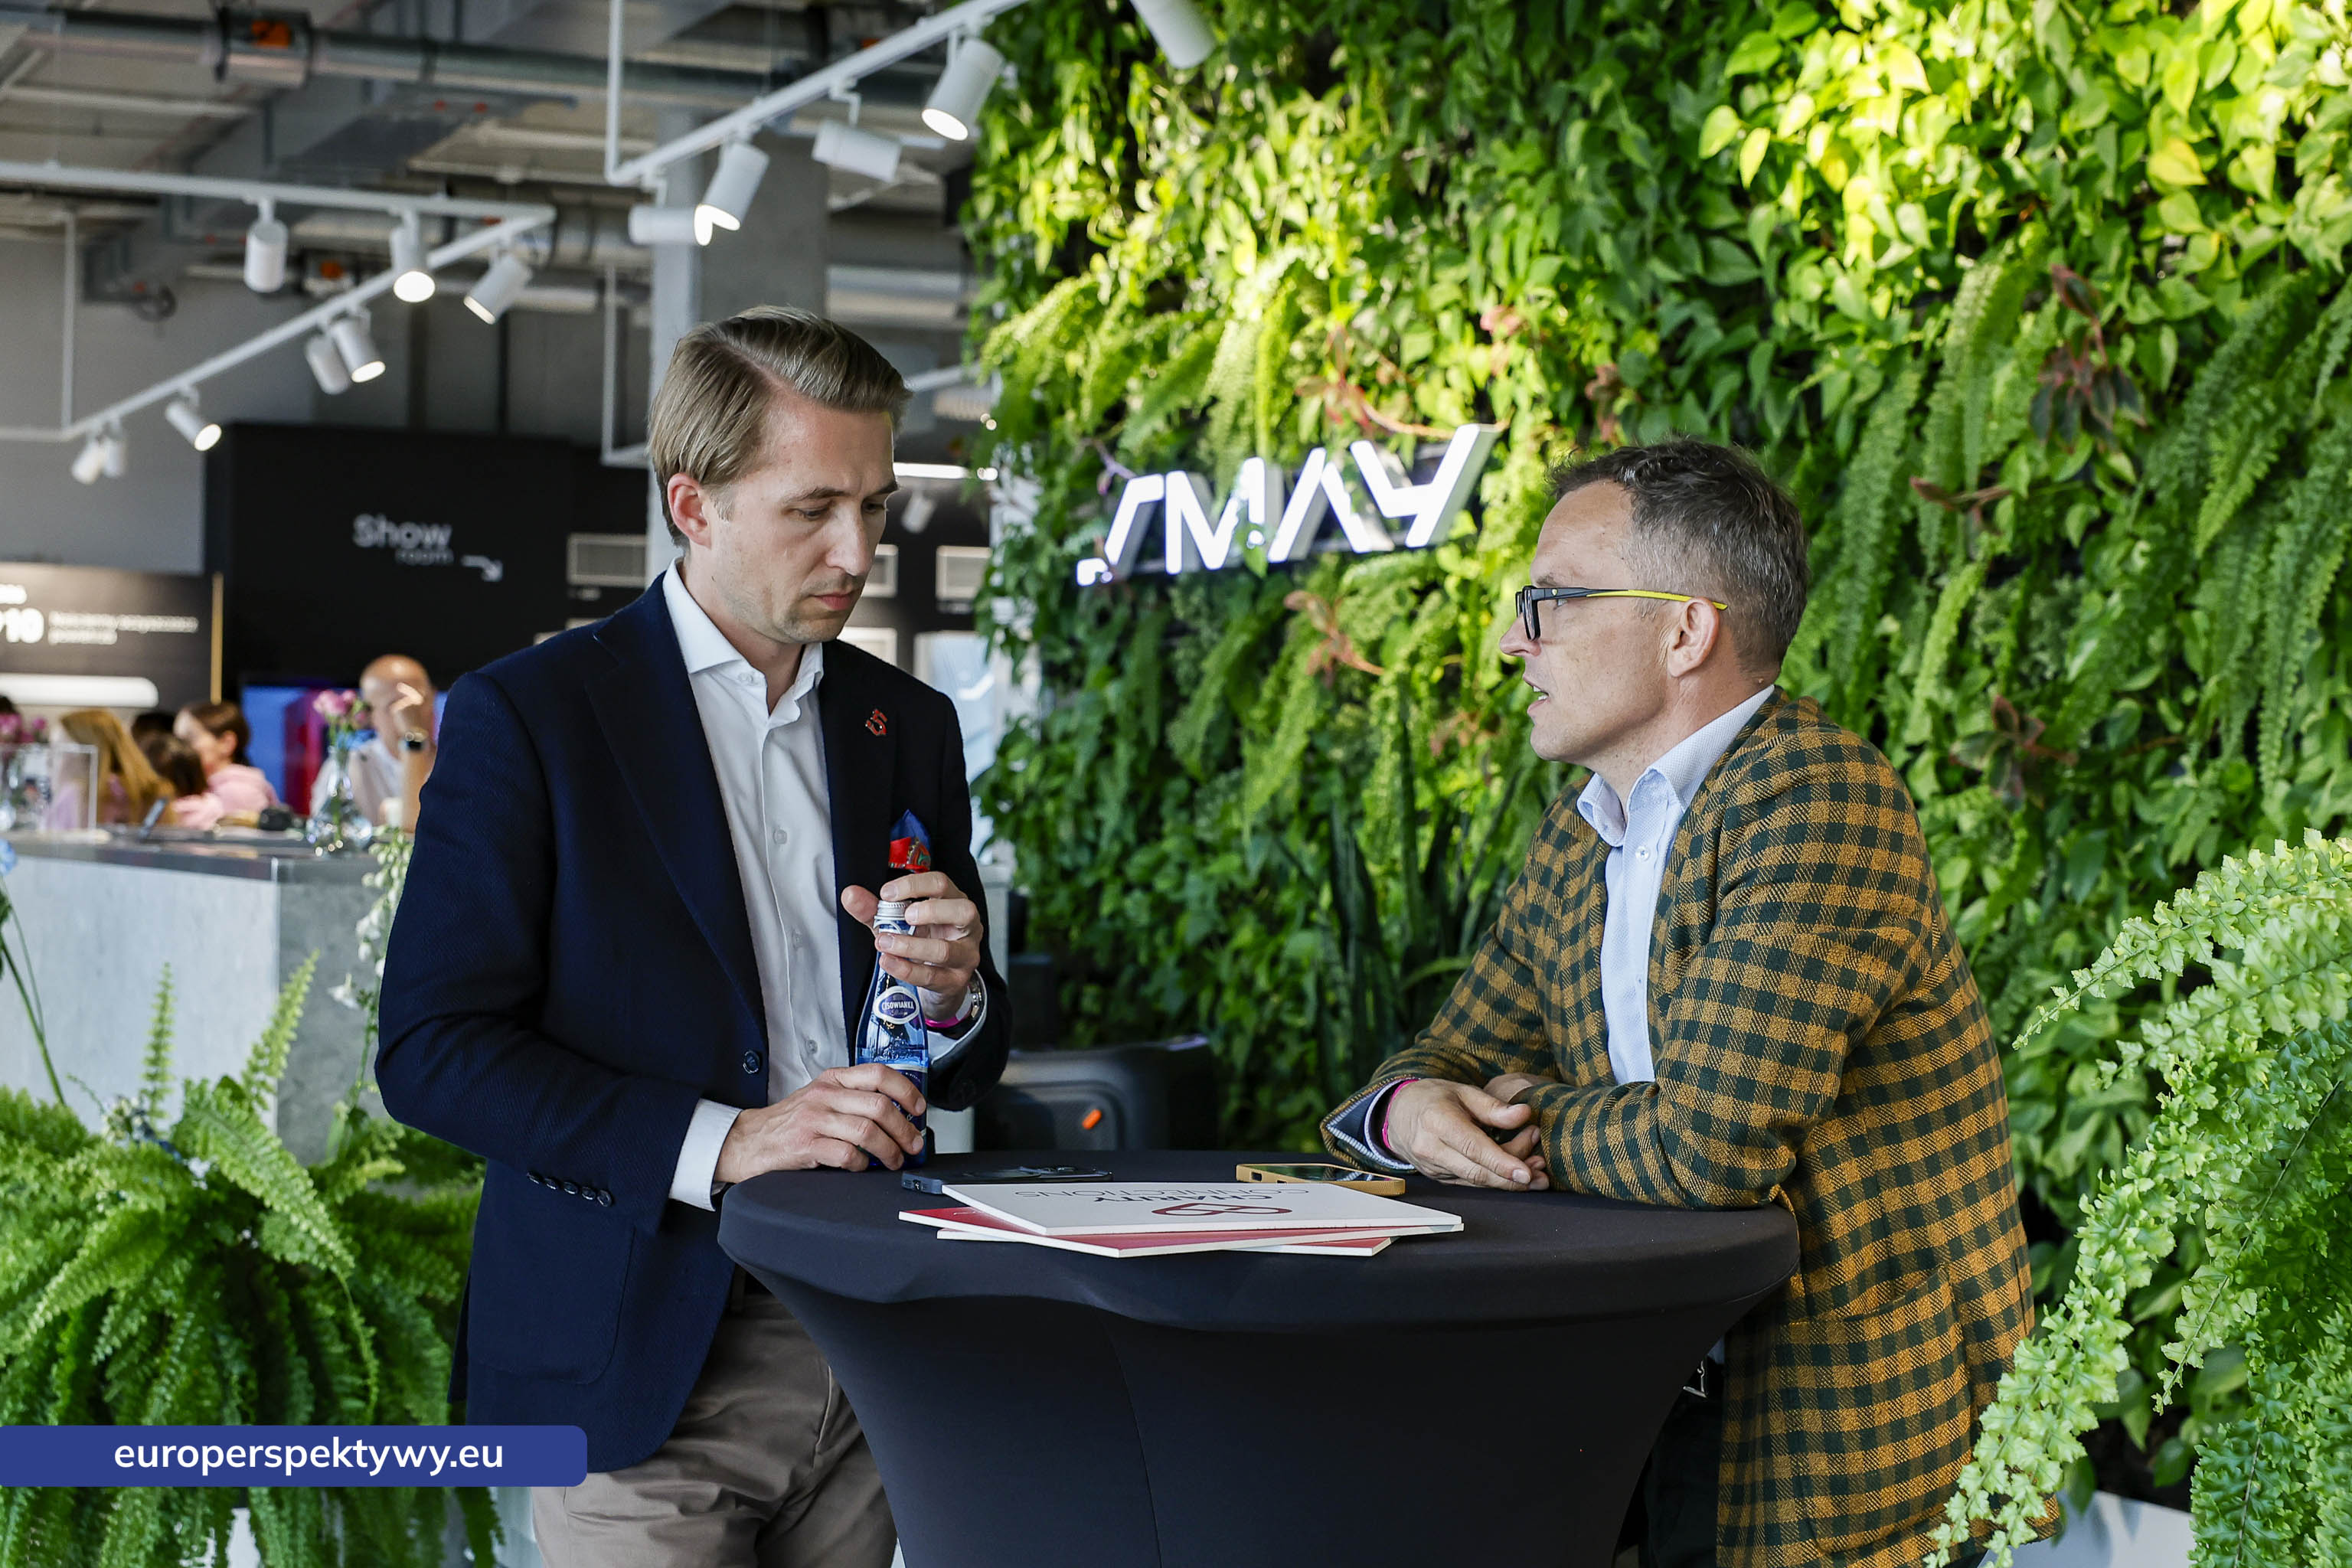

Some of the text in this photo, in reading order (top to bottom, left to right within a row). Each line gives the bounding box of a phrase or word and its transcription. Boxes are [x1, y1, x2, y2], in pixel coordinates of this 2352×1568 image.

[353, 512, 452, 548] Show
[396, 548, 454, 565] room
[1014, 1188, 1309, 1197] CONNECTIONS
[1094, 1194, 1272, 1203] CHARITY
